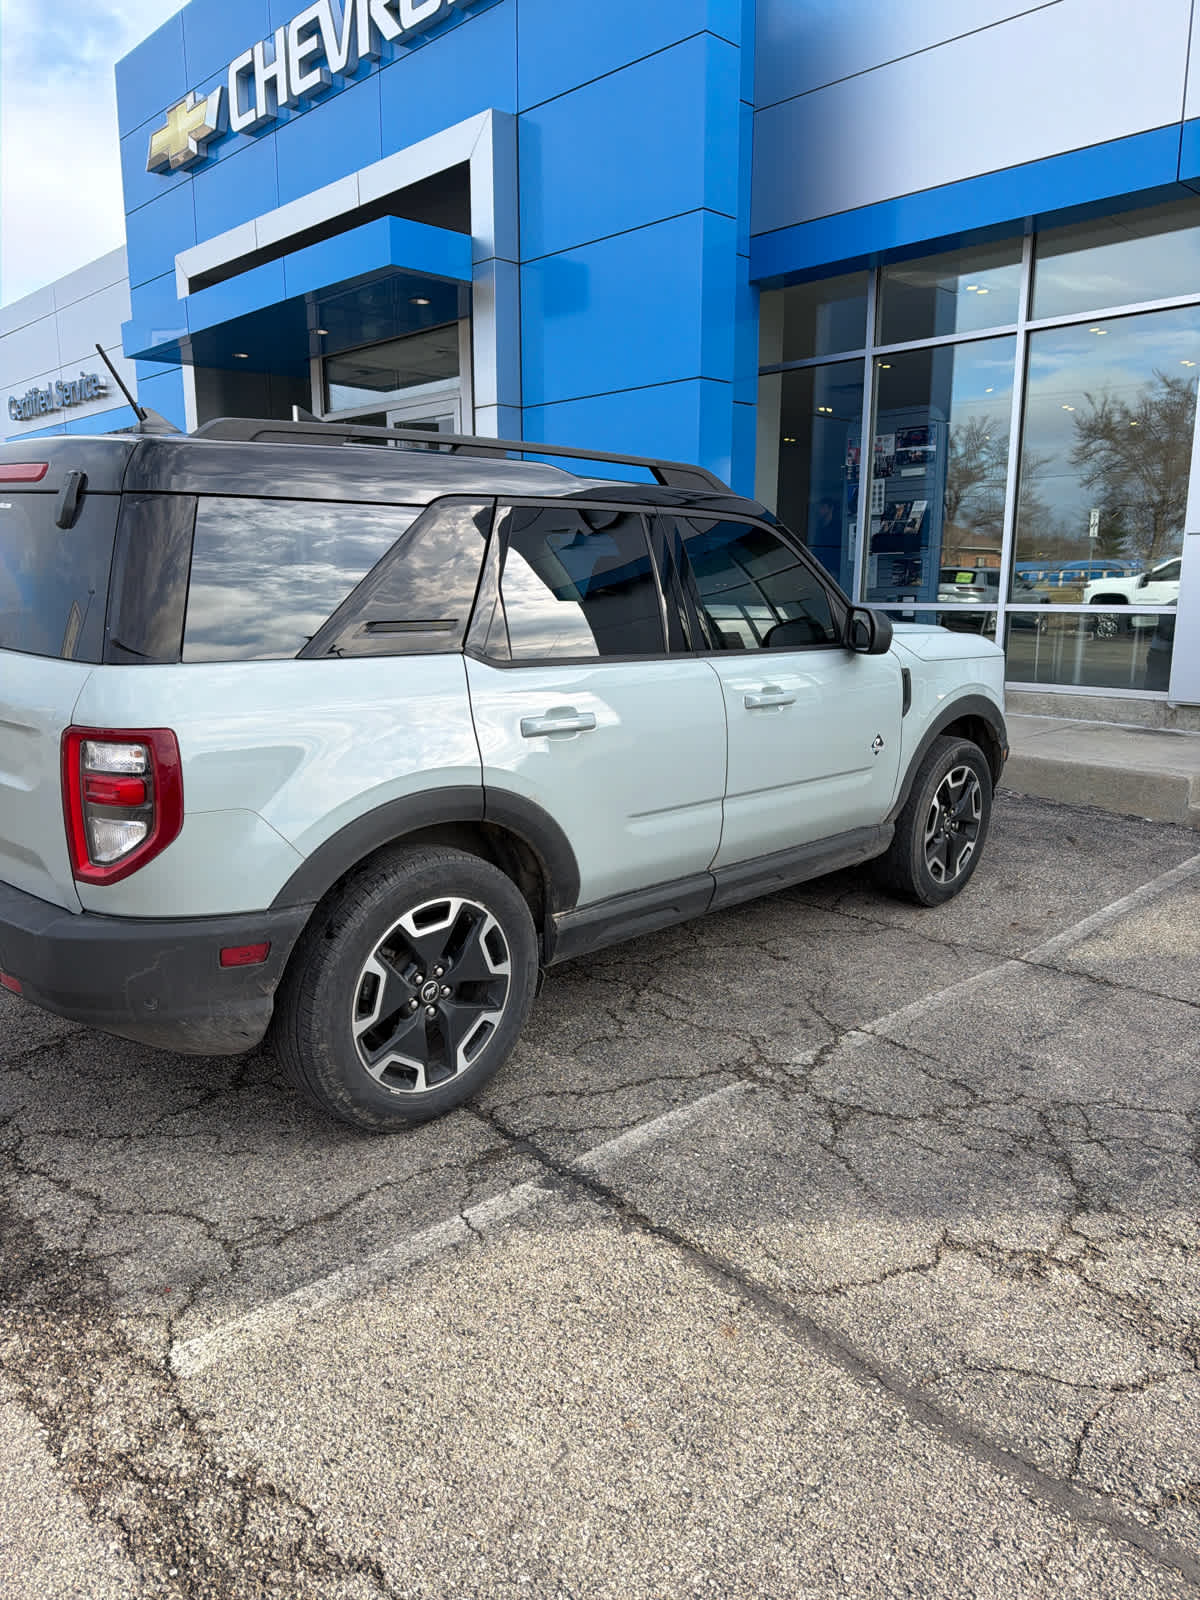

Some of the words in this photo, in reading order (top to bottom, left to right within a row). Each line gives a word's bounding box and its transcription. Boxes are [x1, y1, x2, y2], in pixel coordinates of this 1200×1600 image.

[227, 0, 459, 136] CHEVR
[8, 382, 53, 421] Certified
[55, 371, 100, 408] Service
